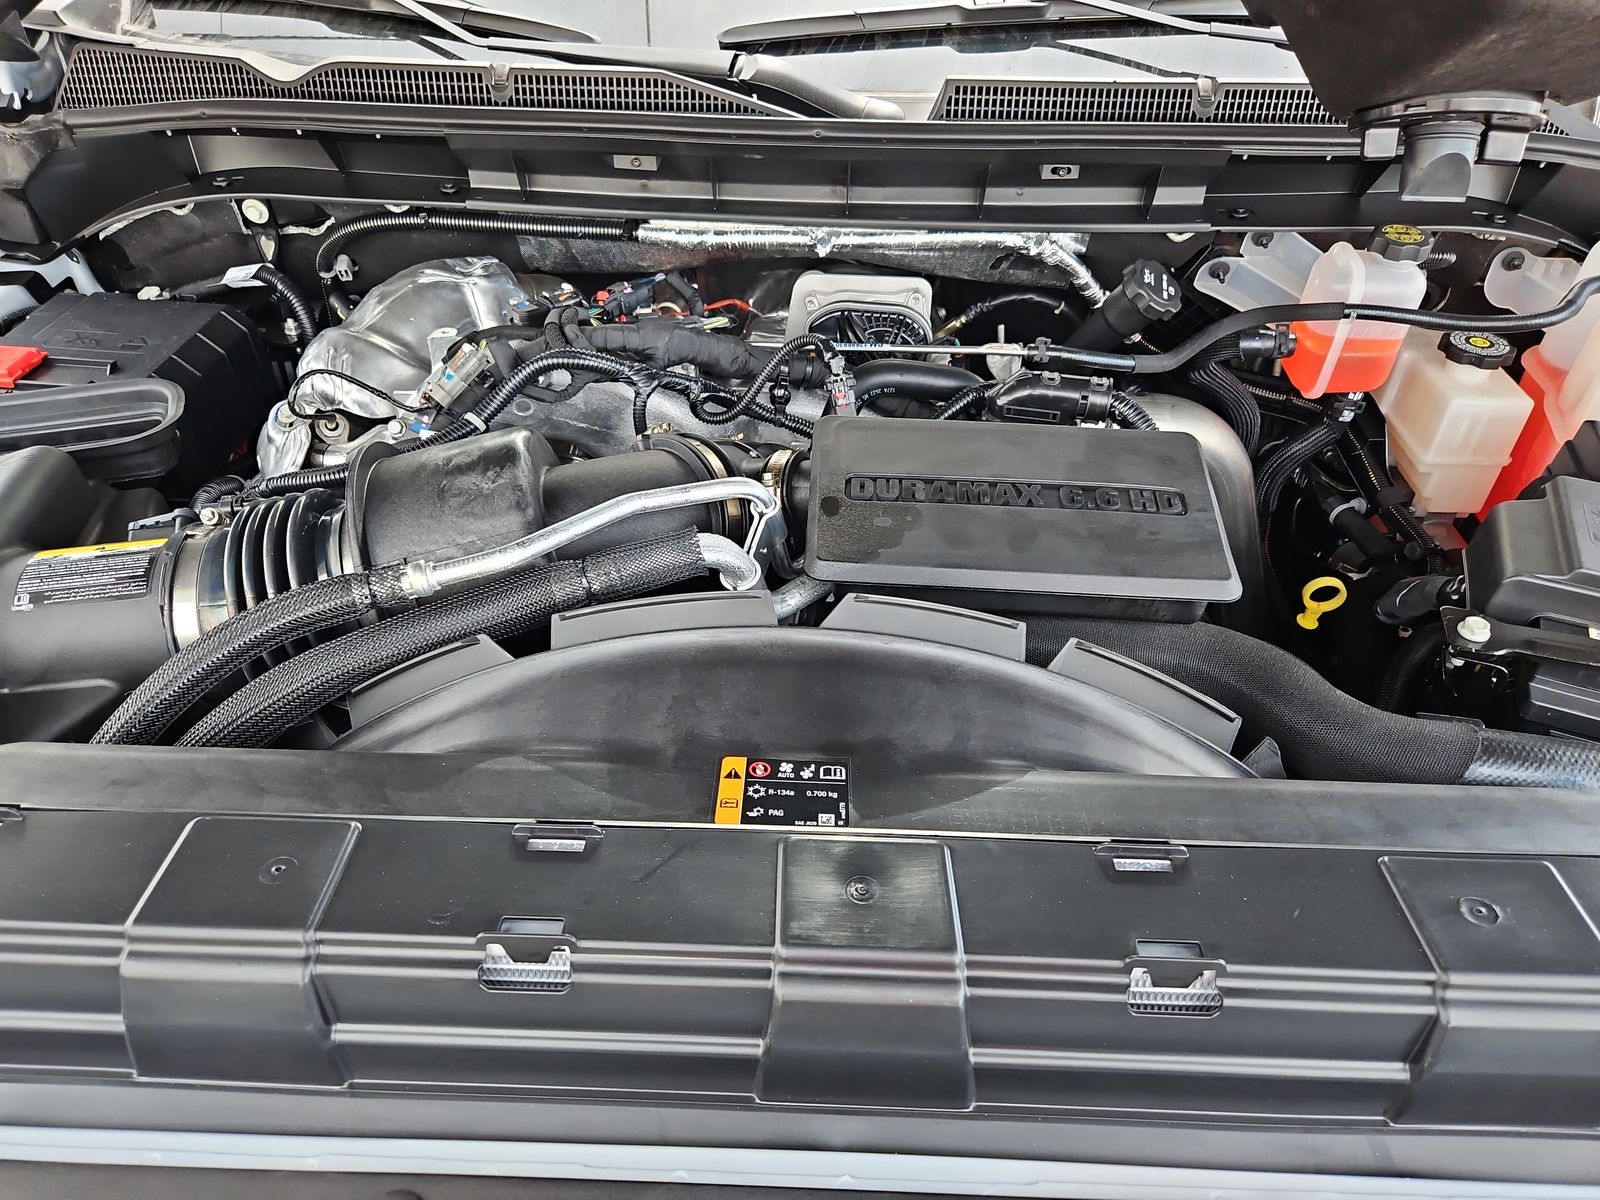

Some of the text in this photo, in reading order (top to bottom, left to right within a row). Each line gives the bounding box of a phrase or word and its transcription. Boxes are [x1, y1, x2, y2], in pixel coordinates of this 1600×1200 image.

[850, 476, 1184, 515] DURAMAX 6.6 HD
[828, 790, 838, 798] kg
